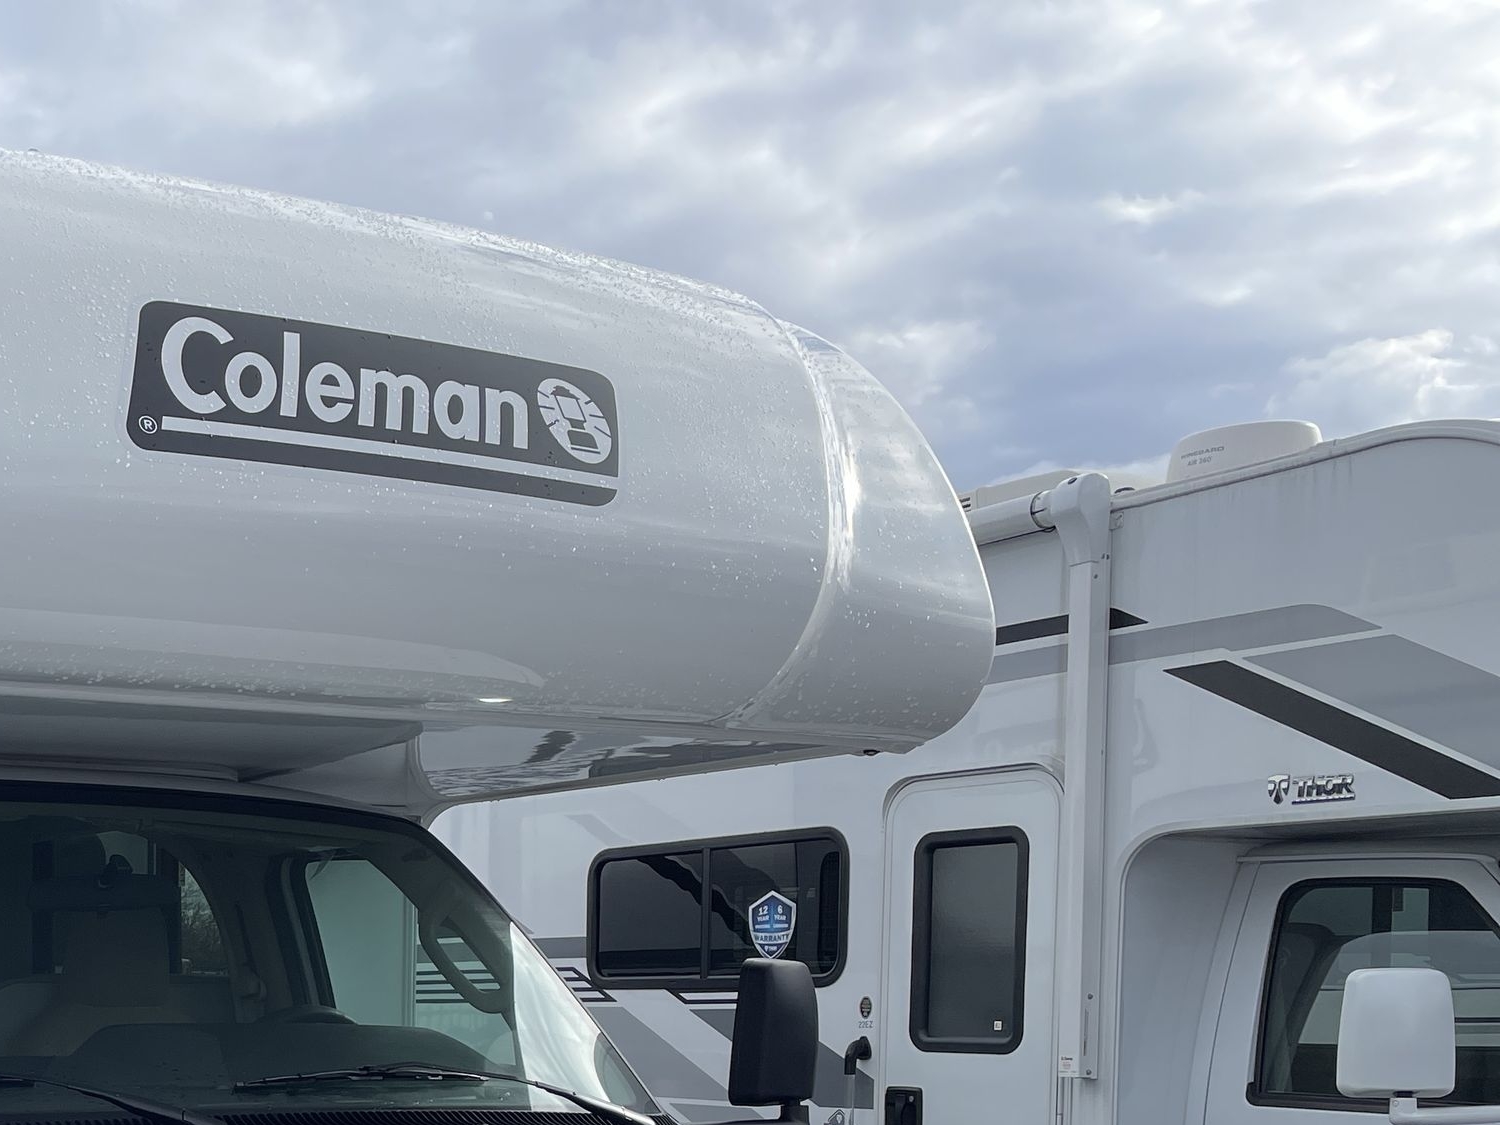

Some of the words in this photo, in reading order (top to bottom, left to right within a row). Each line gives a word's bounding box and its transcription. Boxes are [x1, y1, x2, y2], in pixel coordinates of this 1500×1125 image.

[160, 316, 529, 450] Coleman
[1291, 774, 1355, 798] THOR
[758, 905, 769, 915] 12
[777, 904, 783, 915] 6
[754, 933, 790, 941] WARRANTY
